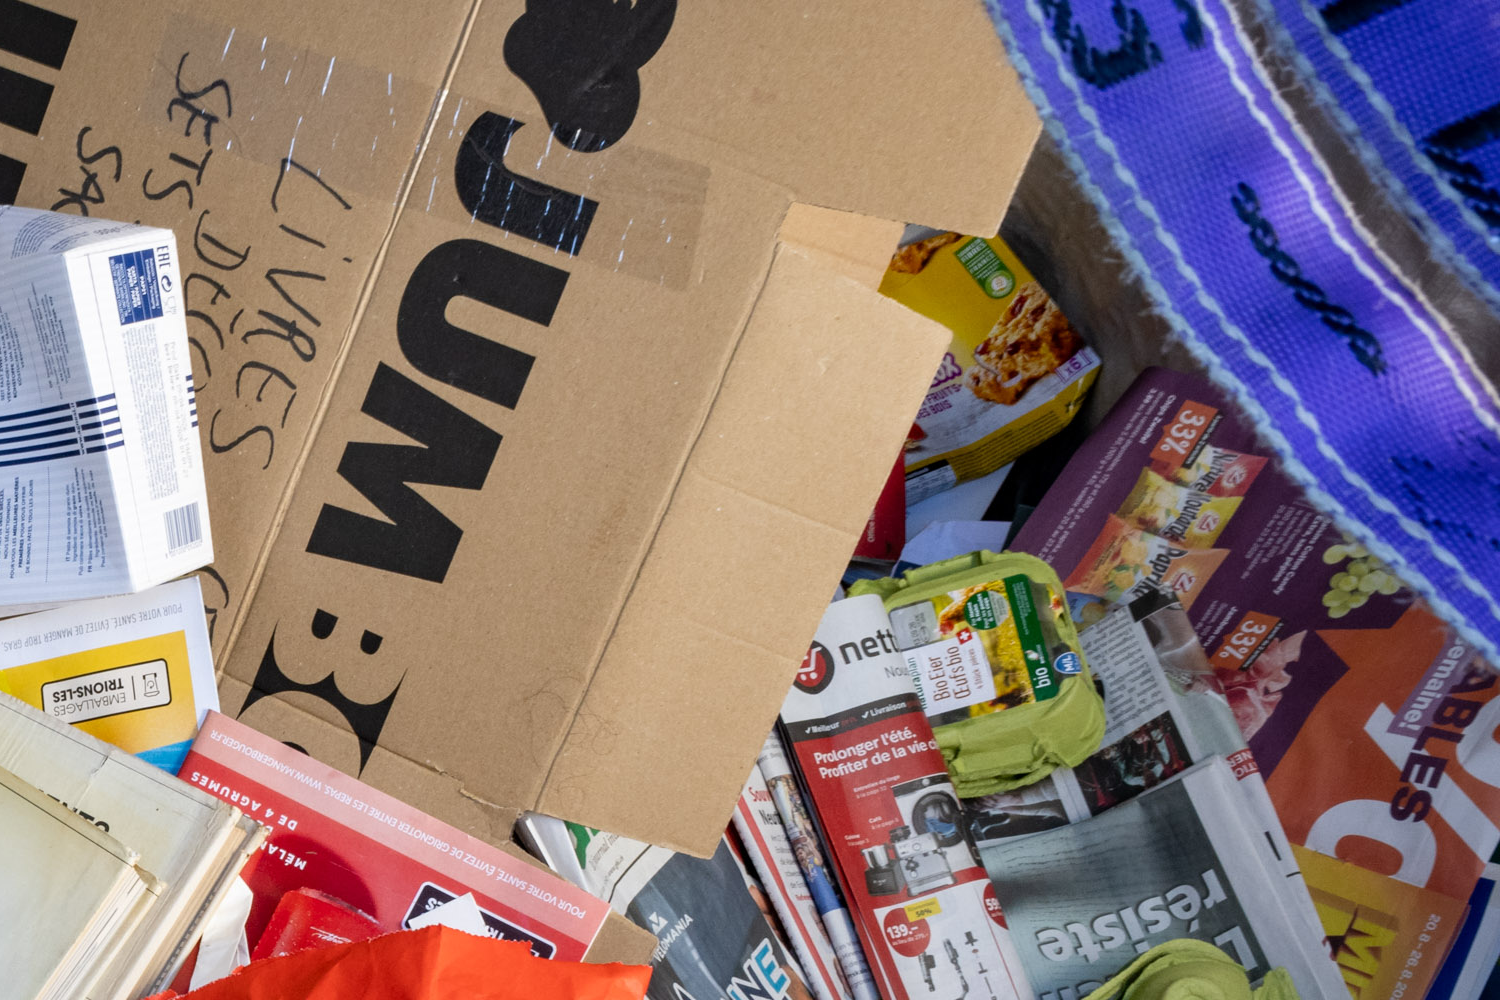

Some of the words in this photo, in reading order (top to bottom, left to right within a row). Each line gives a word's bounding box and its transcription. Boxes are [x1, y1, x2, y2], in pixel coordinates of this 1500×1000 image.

[211, 157, 352, 469] LIVRES
[1160, 407, 1206, 456] 33%
[1272, 571, 1294, 596] Candy
[111, 612, 137, 628] SANTÉ,
[137, 607, 161, 621] VOTRE
[161, 602, 182, 616] POUR
[42, 626, 72, 642] MANGER
[73, 625, 83, 635] DE
[84, 618, 109, 633] ÉVITEZ
[0, 637, 22, 651] GRAS,
[22, 634, 41, 647] TROP
[1217, 618, 1265, 660] 33%
[928, 655, 944, 678] Eier
[947, 645, 961, 665] bio
[1062, 654, 1074, 671] M/L
[951, 666, 971, 698] Œufs
[1034, 666, 1051, 687] bio
[52, 677, 123, 702] TRIONS-LES
[934, 681, 950, 701] Bio
[53, 692, 125, 716] EMBALLAGES
[868, 700, 906, 718] Livraison
[813, 737, 880, 765] Prolonger
[880, 725, 917, 746] l'été.
[208, 727, 322, 792] WWW.MANGERBOUGER.FR
[819, 756, 869, 779] Profiter
[873, 750, 889, 764] de
[891, 745, 906, 759] la
[907, 739, 927, 754] vie
[188, 770, 262, 812] AGRUMES
[320, 782, 352, 806] REPAS.
[263, 807, 275, 819] 4
[350, 797, 369, 814] LES
[366, 805, 398, 828] ENTRE
[276, 813, 298, 830] DE
[395, 819, 450, 854] GRIGNOTER
[447, 845, 463, 860] DE
[460, 851, 496, 877] ÉVITEZ
[492, 867, 527, 893] SANTÉ,
[524, 882, 558, 906] VOTRE
[556, 897, 586, 920] POUR
[1035, 868, 1226, 962] résiste
